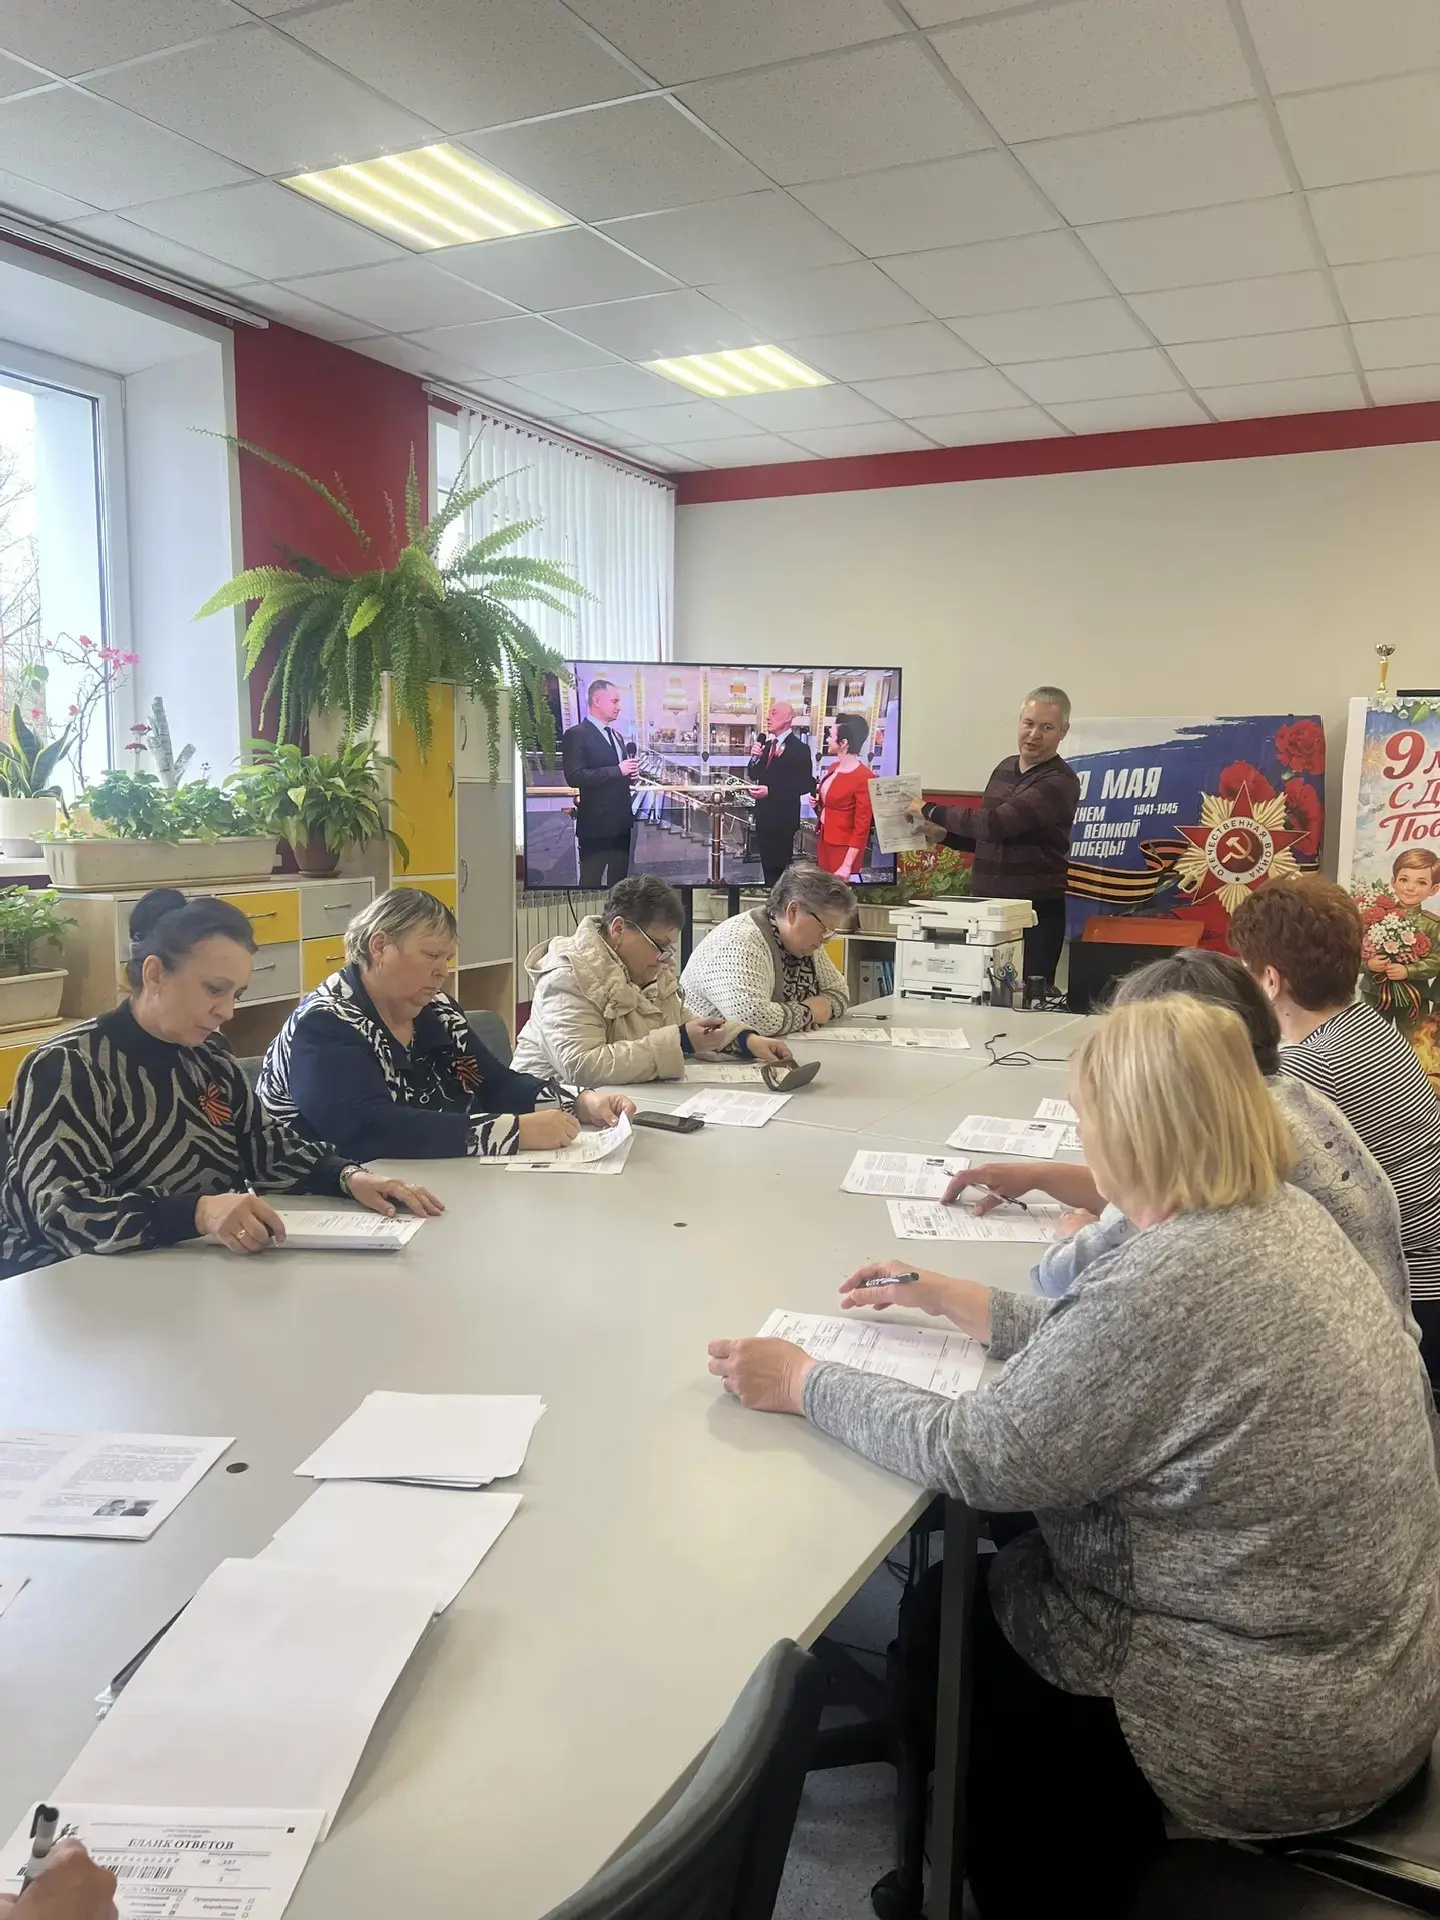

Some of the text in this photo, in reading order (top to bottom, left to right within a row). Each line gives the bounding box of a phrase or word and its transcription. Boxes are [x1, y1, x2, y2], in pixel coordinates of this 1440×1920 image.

[1383, 731, 1425, 780] 9
[1101, 767, 1162, 799] МАЯ
[1133, 802, 1179, 815] 1941-1945
[1083, 819, 1141, 839] ВЕЛИКОЙ
[1070, 840, 1126, 859] ПОБЕДЫ!
[1208, 819, 1272, 878] ОТЕЧЕСТВЕННАЯ ВОЙНА
[128, 1838, 234, 1849] БЛАНК ОТВЕТОВ
